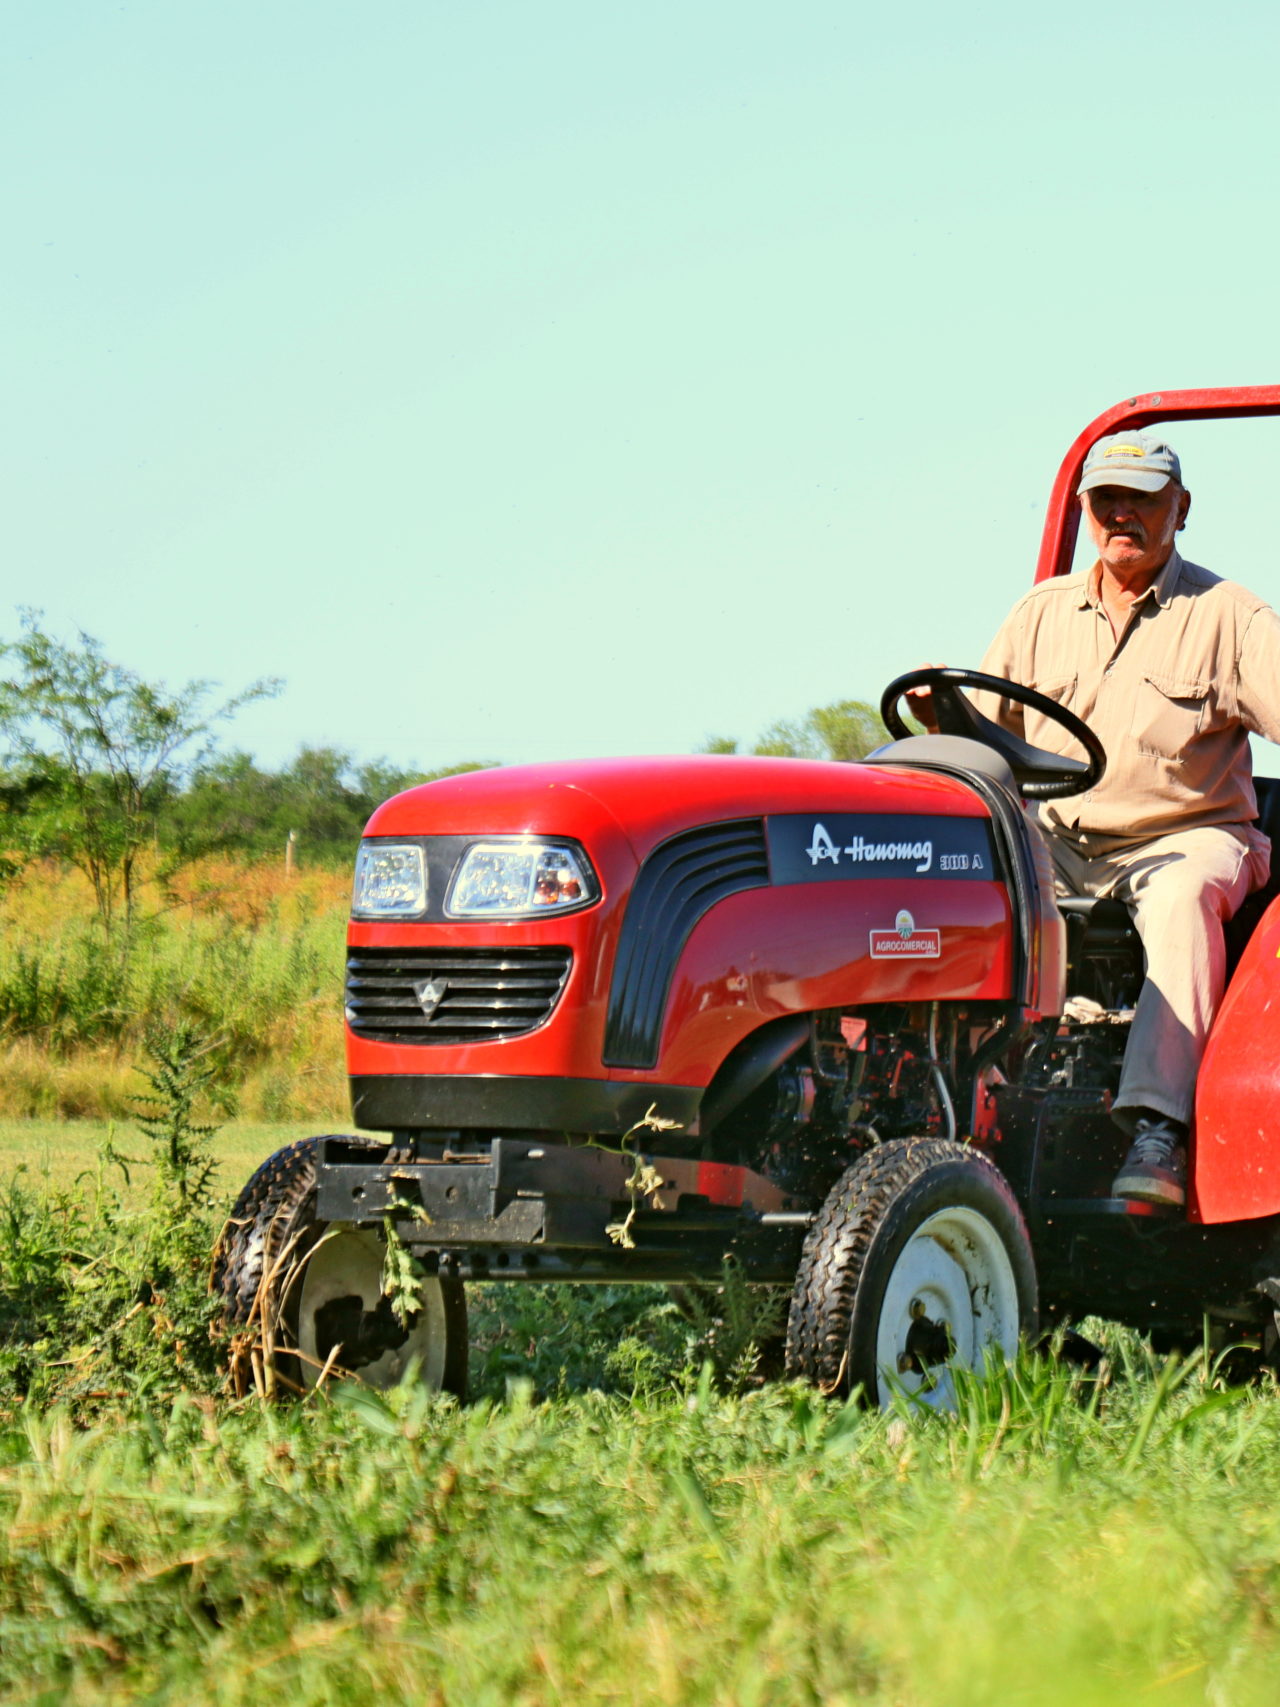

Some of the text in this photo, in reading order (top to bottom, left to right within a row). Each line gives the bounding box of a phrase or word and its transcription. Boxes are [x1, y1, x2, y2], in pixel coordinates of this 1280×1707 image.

[844, 836, 932, 872] Hanomag
[972, 854, 984, 870] A
[876, 940, 937, 952] AGROCOMERCIAL
